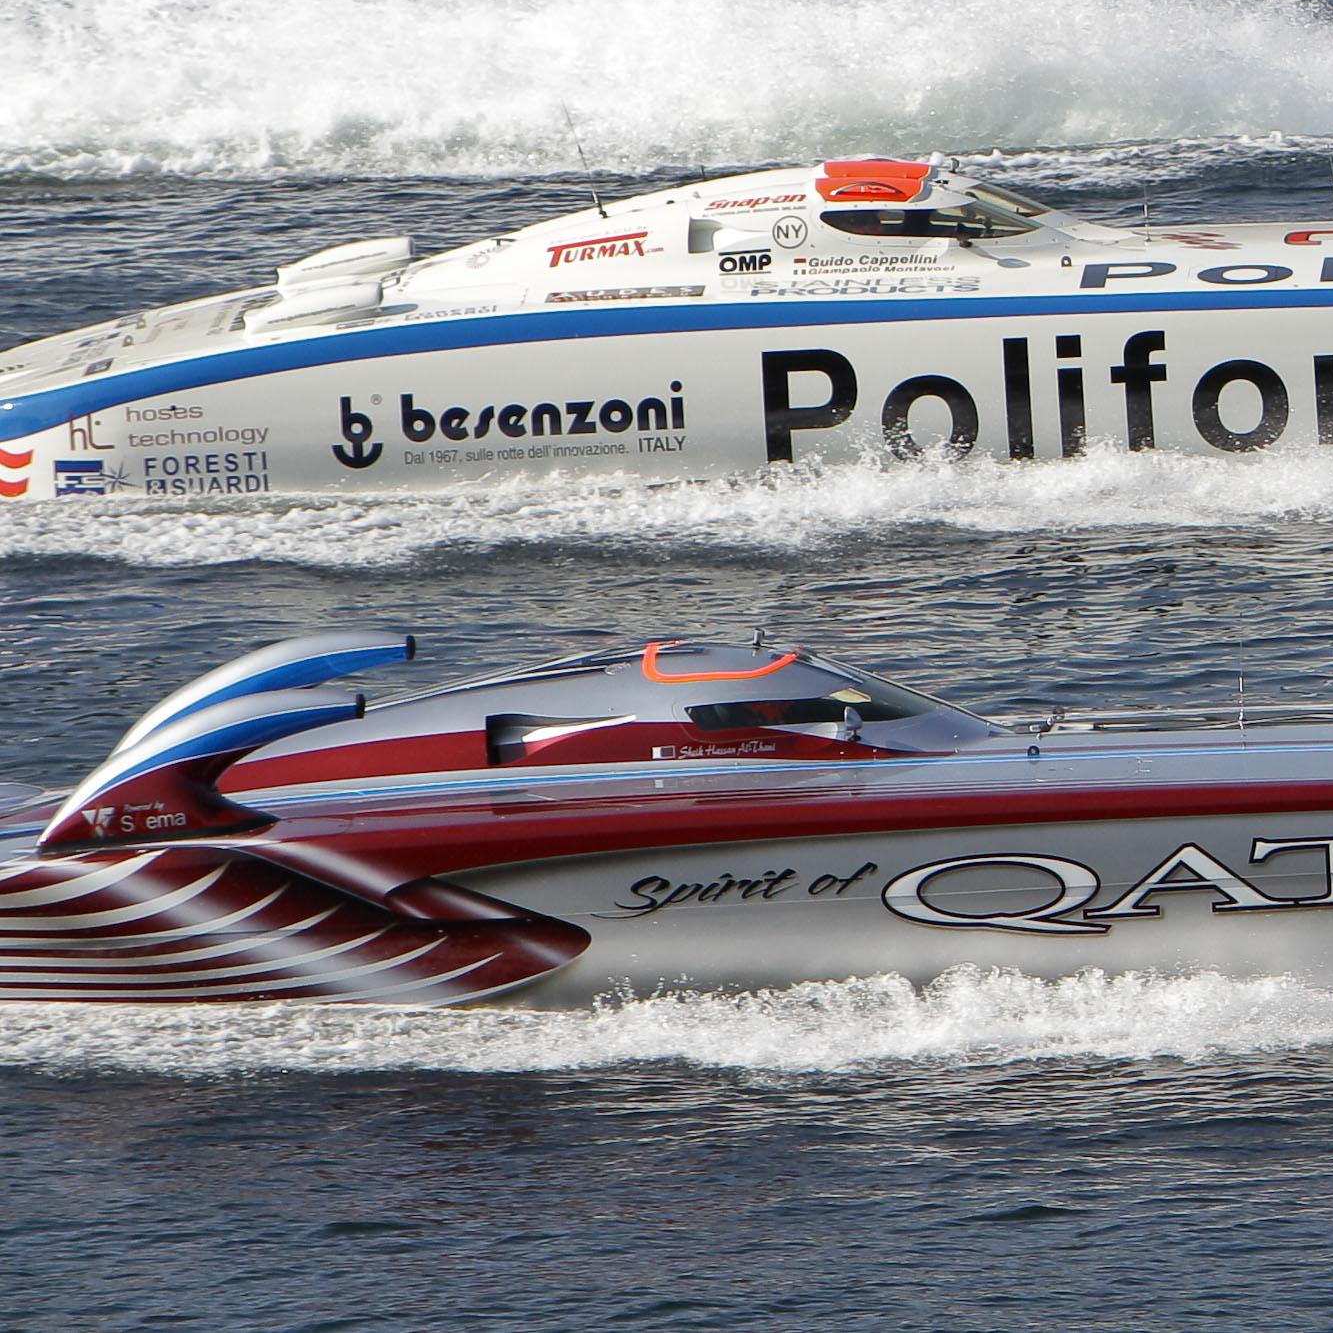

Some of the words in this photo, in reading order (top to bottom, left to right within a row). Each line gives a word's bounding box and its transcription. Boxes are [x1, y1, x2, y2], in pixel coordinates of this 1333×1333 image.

[776, 224, 803, 240] NY
[719, 254, 772, 273] OMP
[808, 256, 854, 267] Guido
[858, 254, 938, 266] Cappellini
[125, 405, 204, 423] hoses
[400, 379, 686, 443] besenzoni
[128, 425, 269, 448] technology
[404, 450, 425, 465] Dal
[466, 447, 494, 463] sulle
[497, 446, 525, 461] rotte
[638, 435, 687, 454] ITALY
[144, 450, 268, 476] FORESTI
[591, 867, 799, 919] Spirit
[807, 861, 878, 898] of
